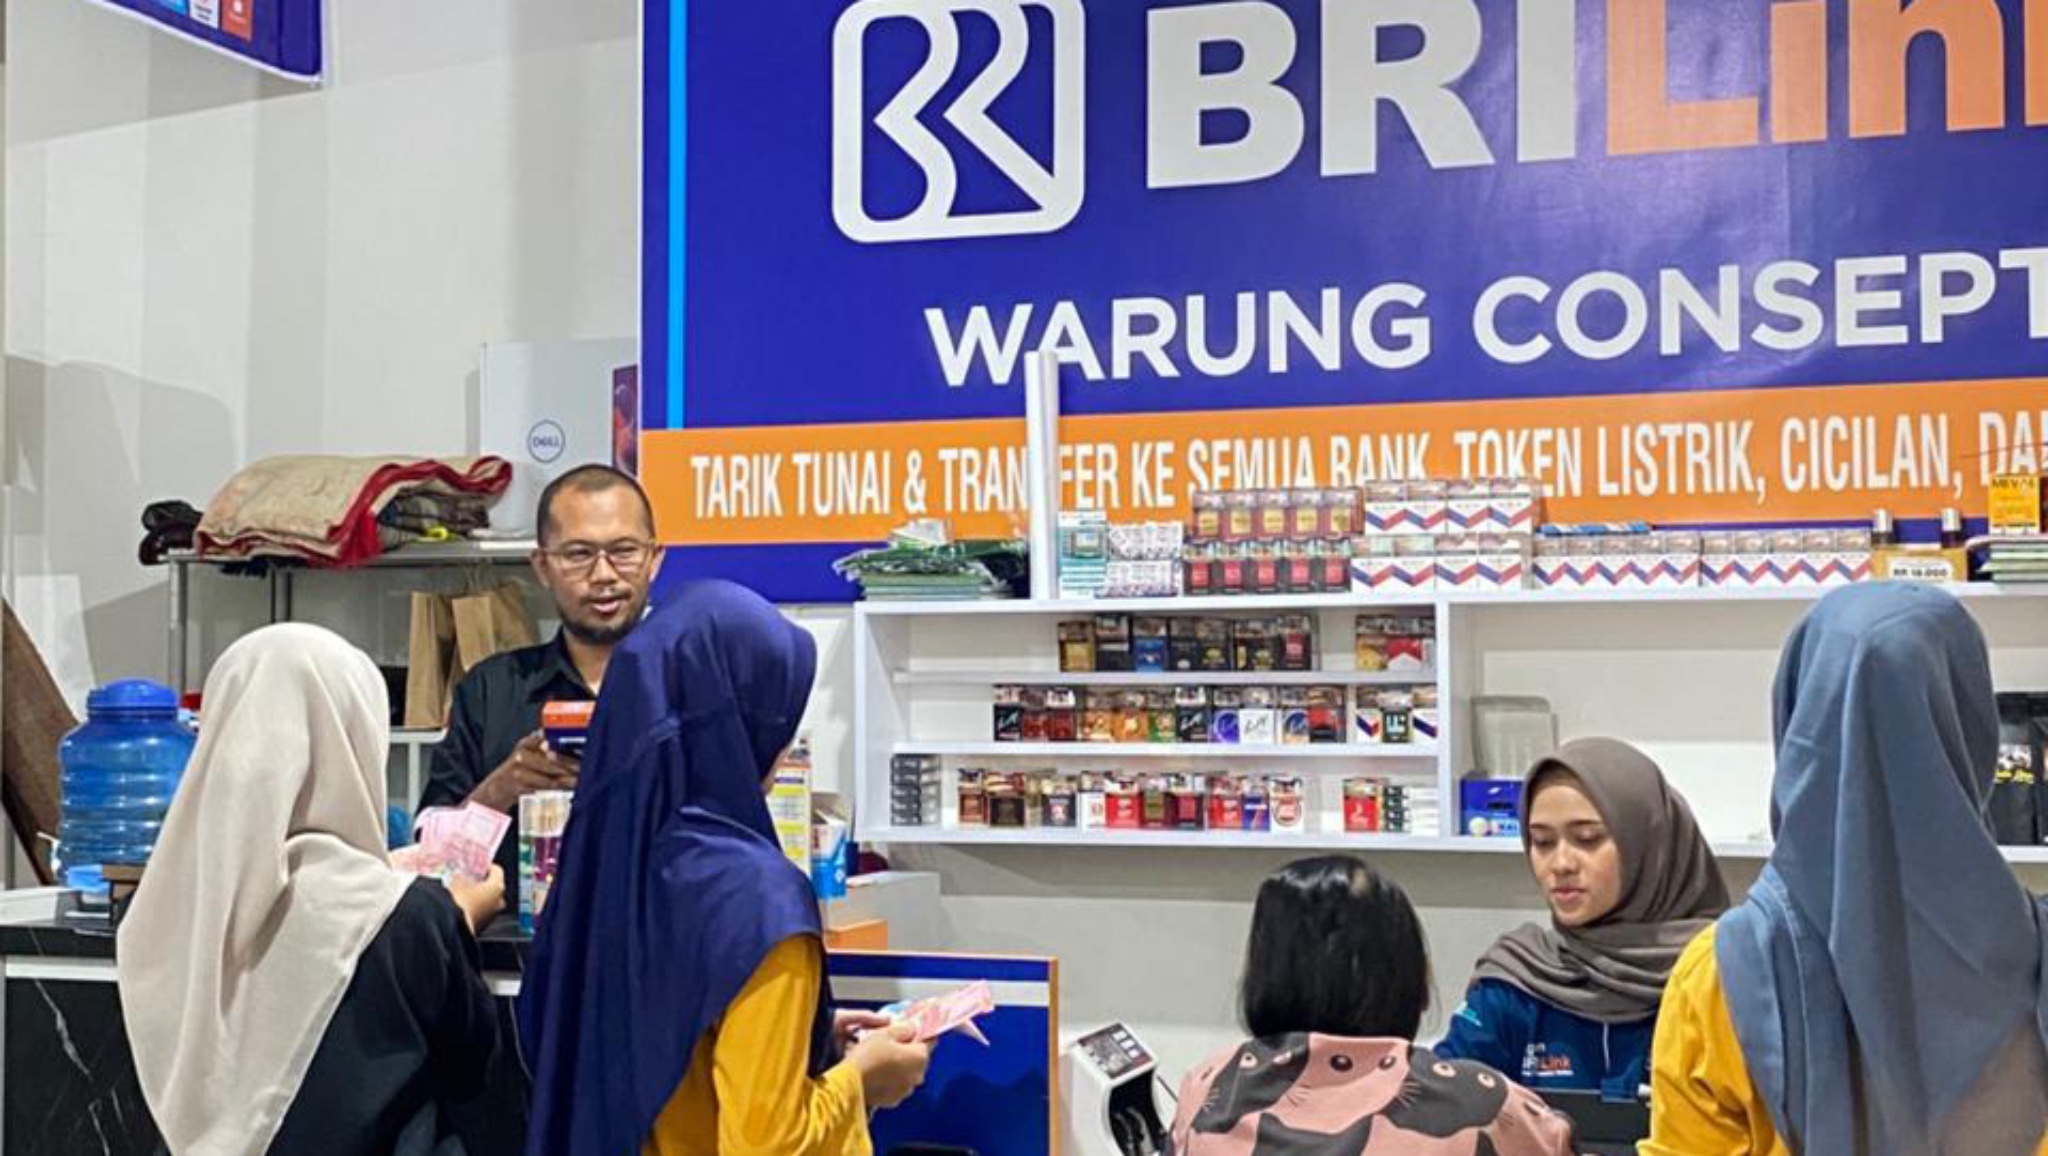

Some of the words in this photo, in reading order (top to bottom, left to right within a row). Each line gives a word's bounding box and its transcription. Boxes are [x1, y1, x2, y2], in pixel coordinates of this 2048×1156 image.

[923, 282, 1431, 386] WARUNG
[1473, 247, 2048, 364] CONSEPT
[690, 454, 783, 518] TARIK
[792, 450, 890, 517] TUNAI
[903, 449, 928, 513] &
[938, 443, 1120, 513] TRANFER
[1132, 440, 1175, 508] KE
[1454, 426, 1582, 497] TOKEN
[1598, 420, 1766, 505] LISTRIK,
[1780, 413, 1963, 500] CICILAN,
